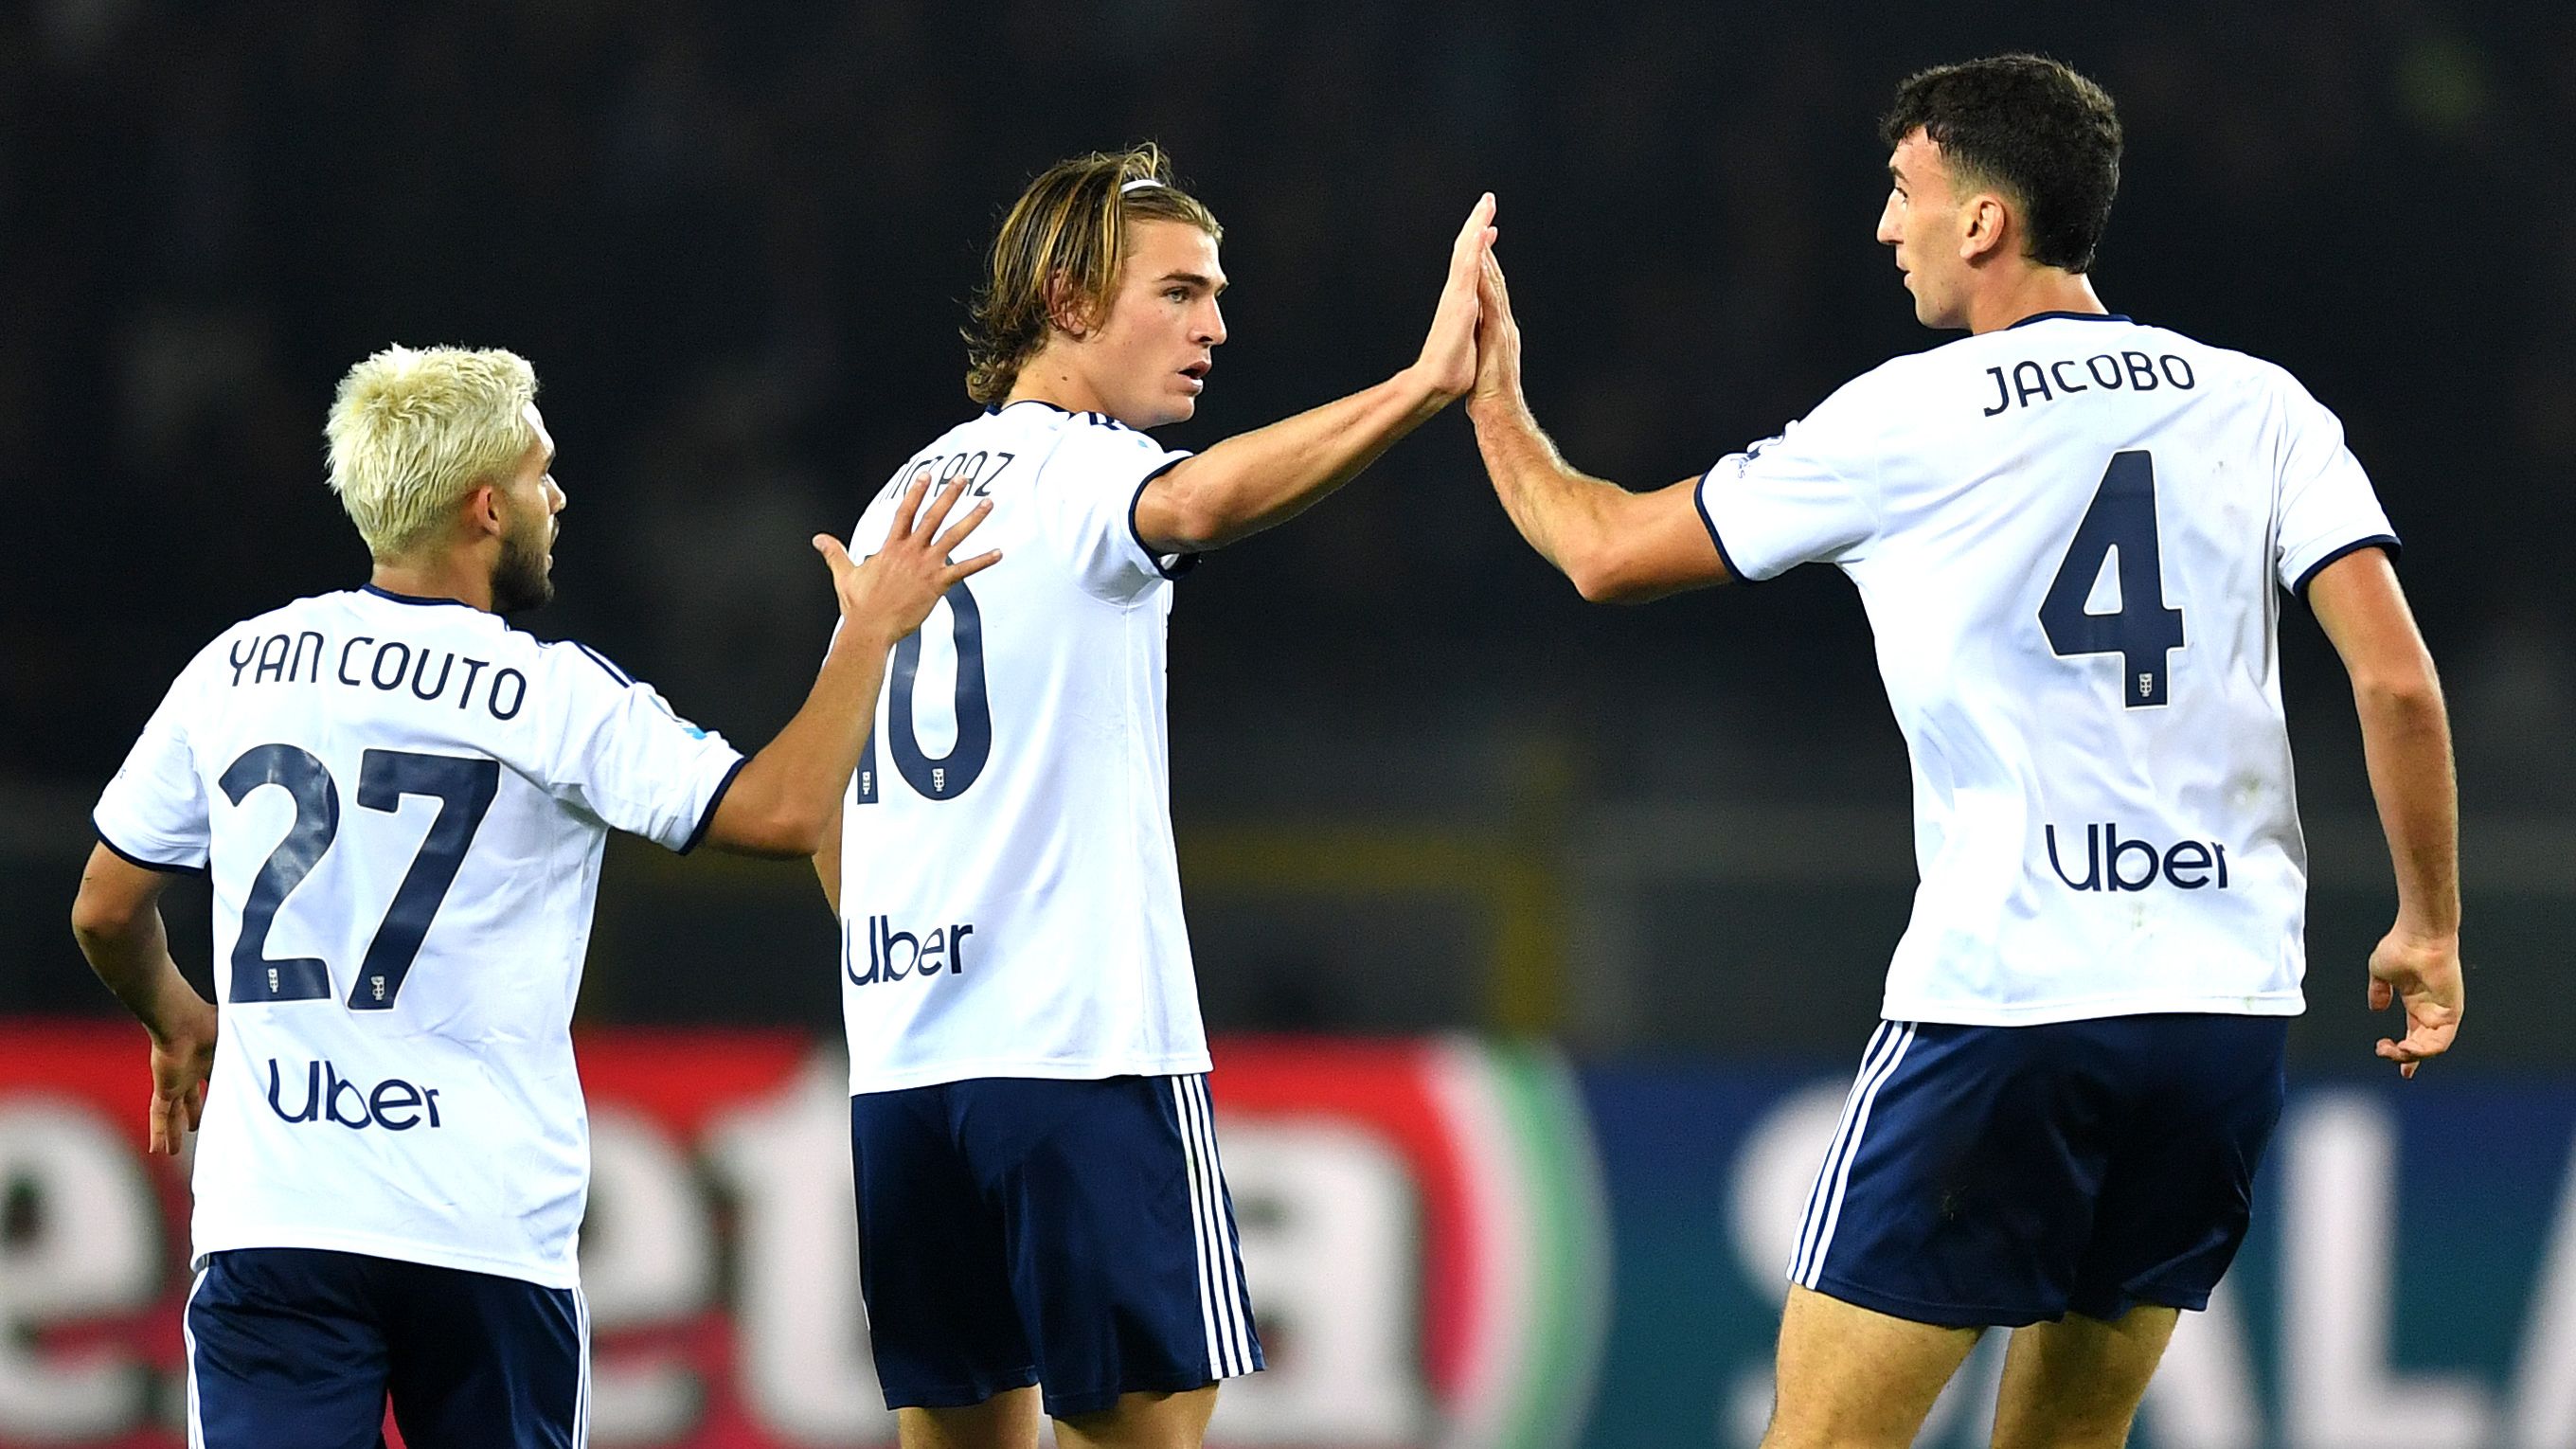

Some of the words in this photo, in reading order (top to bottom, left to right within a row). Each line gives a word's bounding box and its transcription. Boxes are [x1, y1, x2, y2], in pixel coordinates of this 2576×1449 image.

[1983, 350, 2195, 418] JACOBO
[933, 450, 1016, 498] PAZ
[2037, 449, 2186, 708] 4
[229, 631, 324, 687] YAN
[338, 636, 528, 721] COUTO
[856, 551, 993, 805] 0
[217, 742, 501, 1011] 27
[2045, 822, 2228, 892] Uber
[846, 914, 974, 987] Uber
[267, 1058, 440, 1131] Uber
